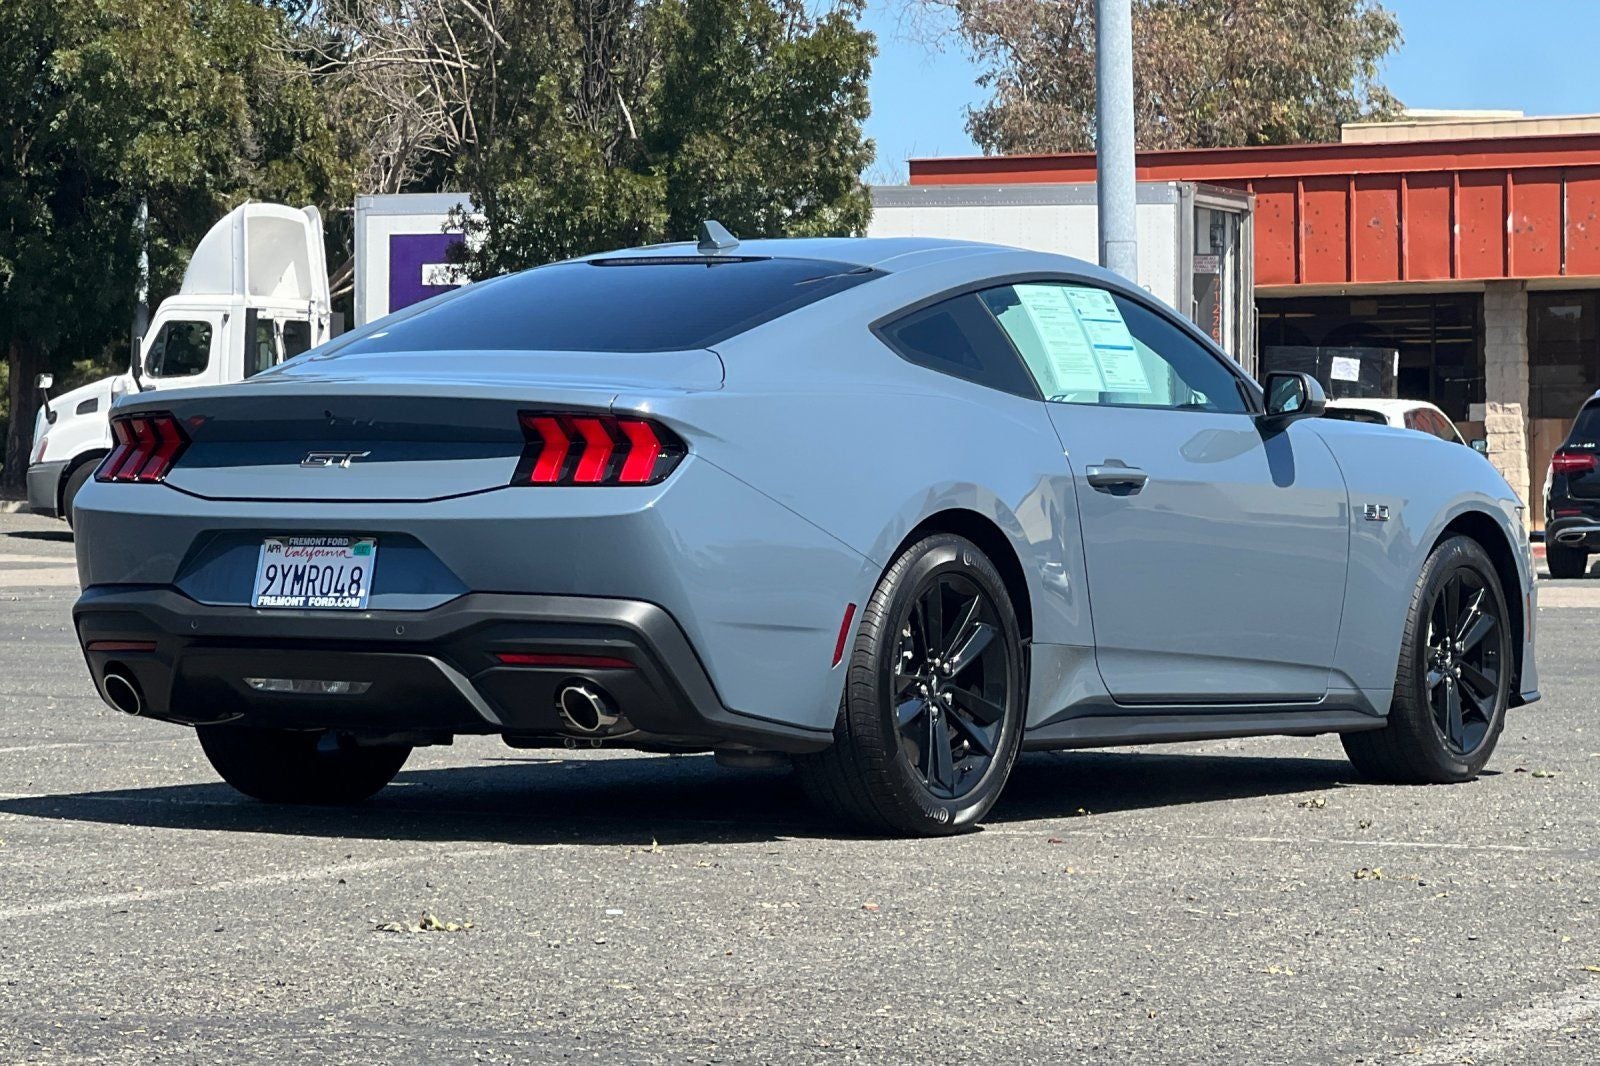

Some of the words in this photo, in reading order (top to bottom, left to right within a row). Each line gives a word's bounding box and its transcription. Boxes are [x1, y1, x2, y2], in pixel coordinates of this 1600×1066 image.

[300, 451, 371, 468] GT
[266, 544, 282, 553] APR
[288, 537, 326, 546] FREMONT
[327, 538, 349, 546] FORD
[285, 545, 353, 563] California
[261, 564, 363, 597] 9YMR048
[257, 596, 306, 606] FREMONT
[308, 597, 361, 607] FORD.COM
